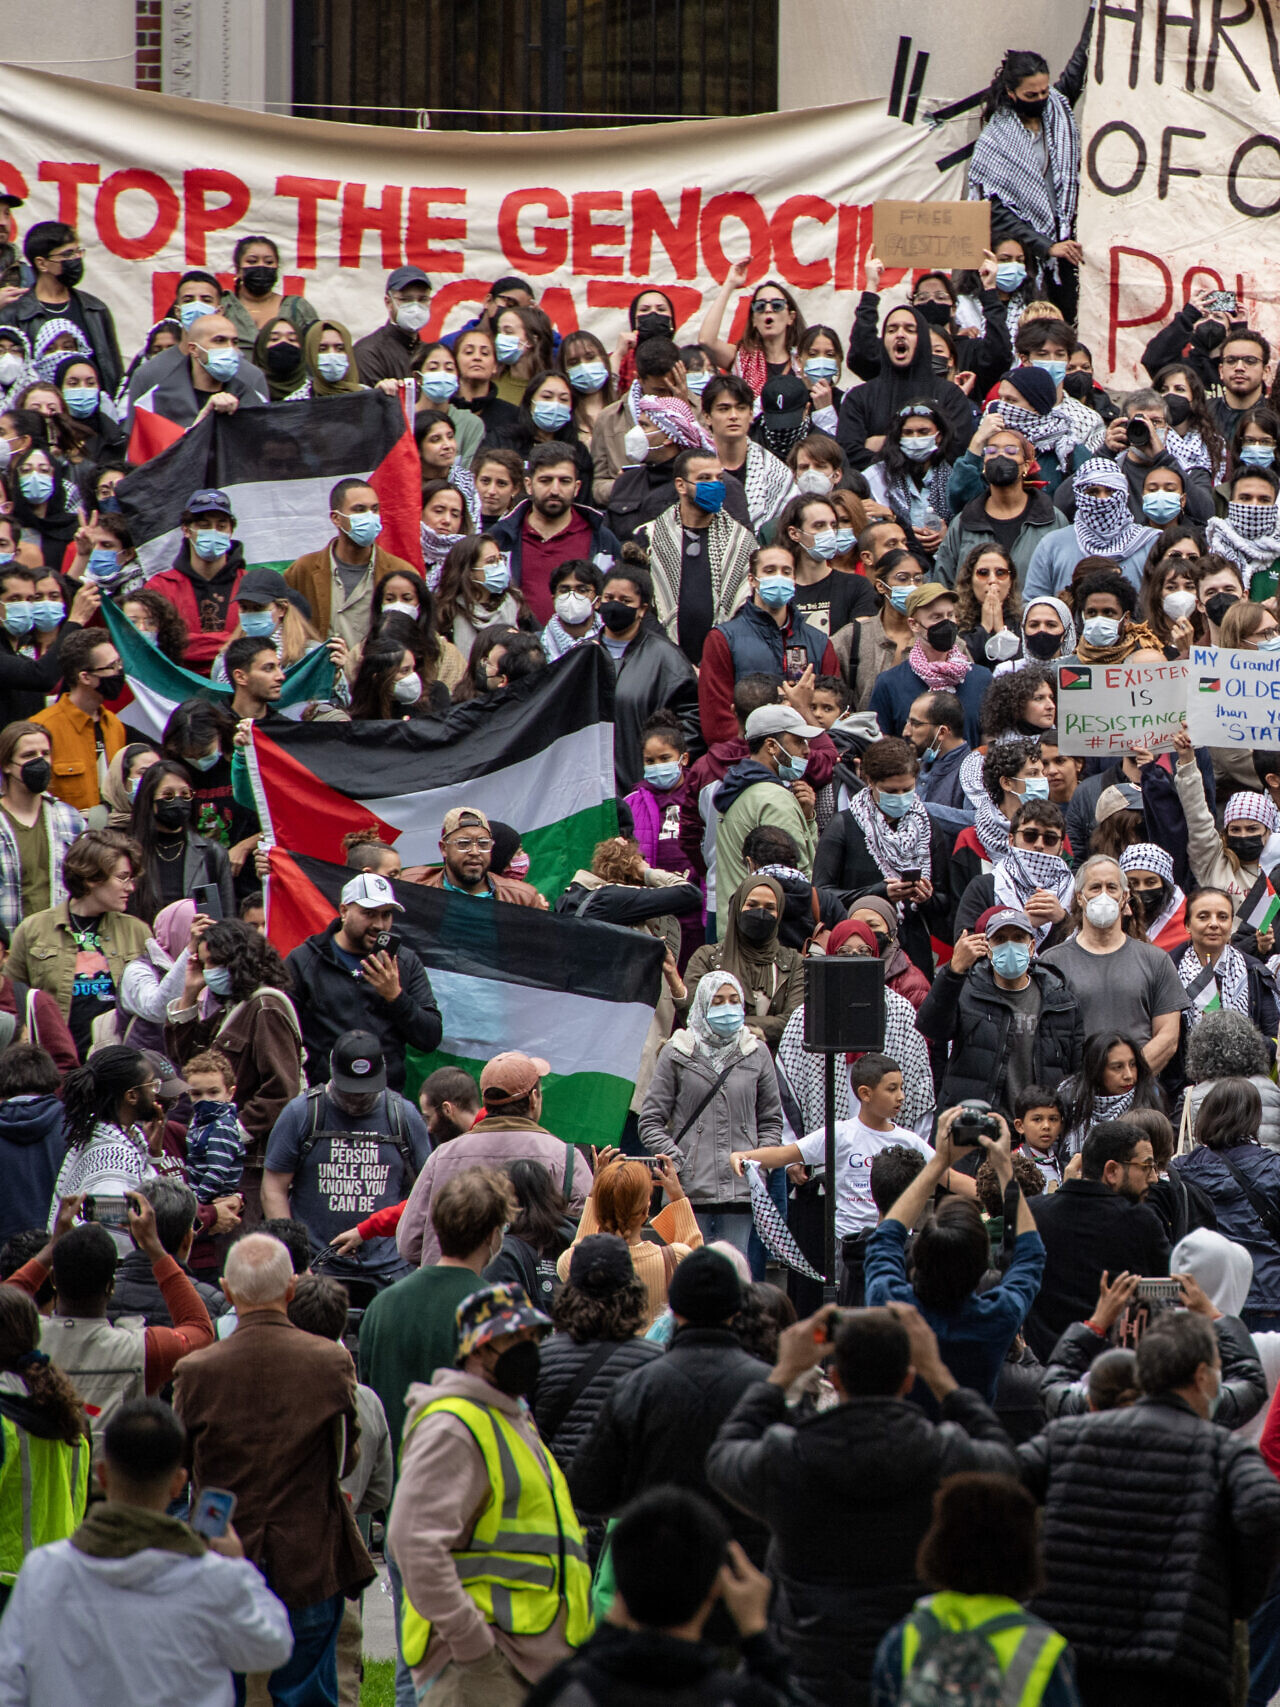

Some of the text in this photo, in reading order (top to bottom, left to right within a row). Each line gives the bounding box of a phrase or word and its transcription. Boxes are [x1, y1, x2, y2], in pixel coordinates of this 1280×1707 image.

[1087, 121, 1207, 200] OF
[899, 208, 952, 225] FREE
[275, 176, 468, 273] THE
[499, 187, 950, 292] GENOCI
[1194, 650, 1219, 667] MY
[1131, 689, 1153, 707] IS
[1215, 703, 1247, 720] than
[1065, 711, 1186, 735] RESISTANCE
[351, 1132, 378, 1148] THE
[331, 1148, 379, 1164] PERSON
[318, 1163, 390, 1180] UNCLE IROH
[318, 1179, 387, 1195] KNOWS YOU
[328, 1195, 376, 1212] CAN BE
